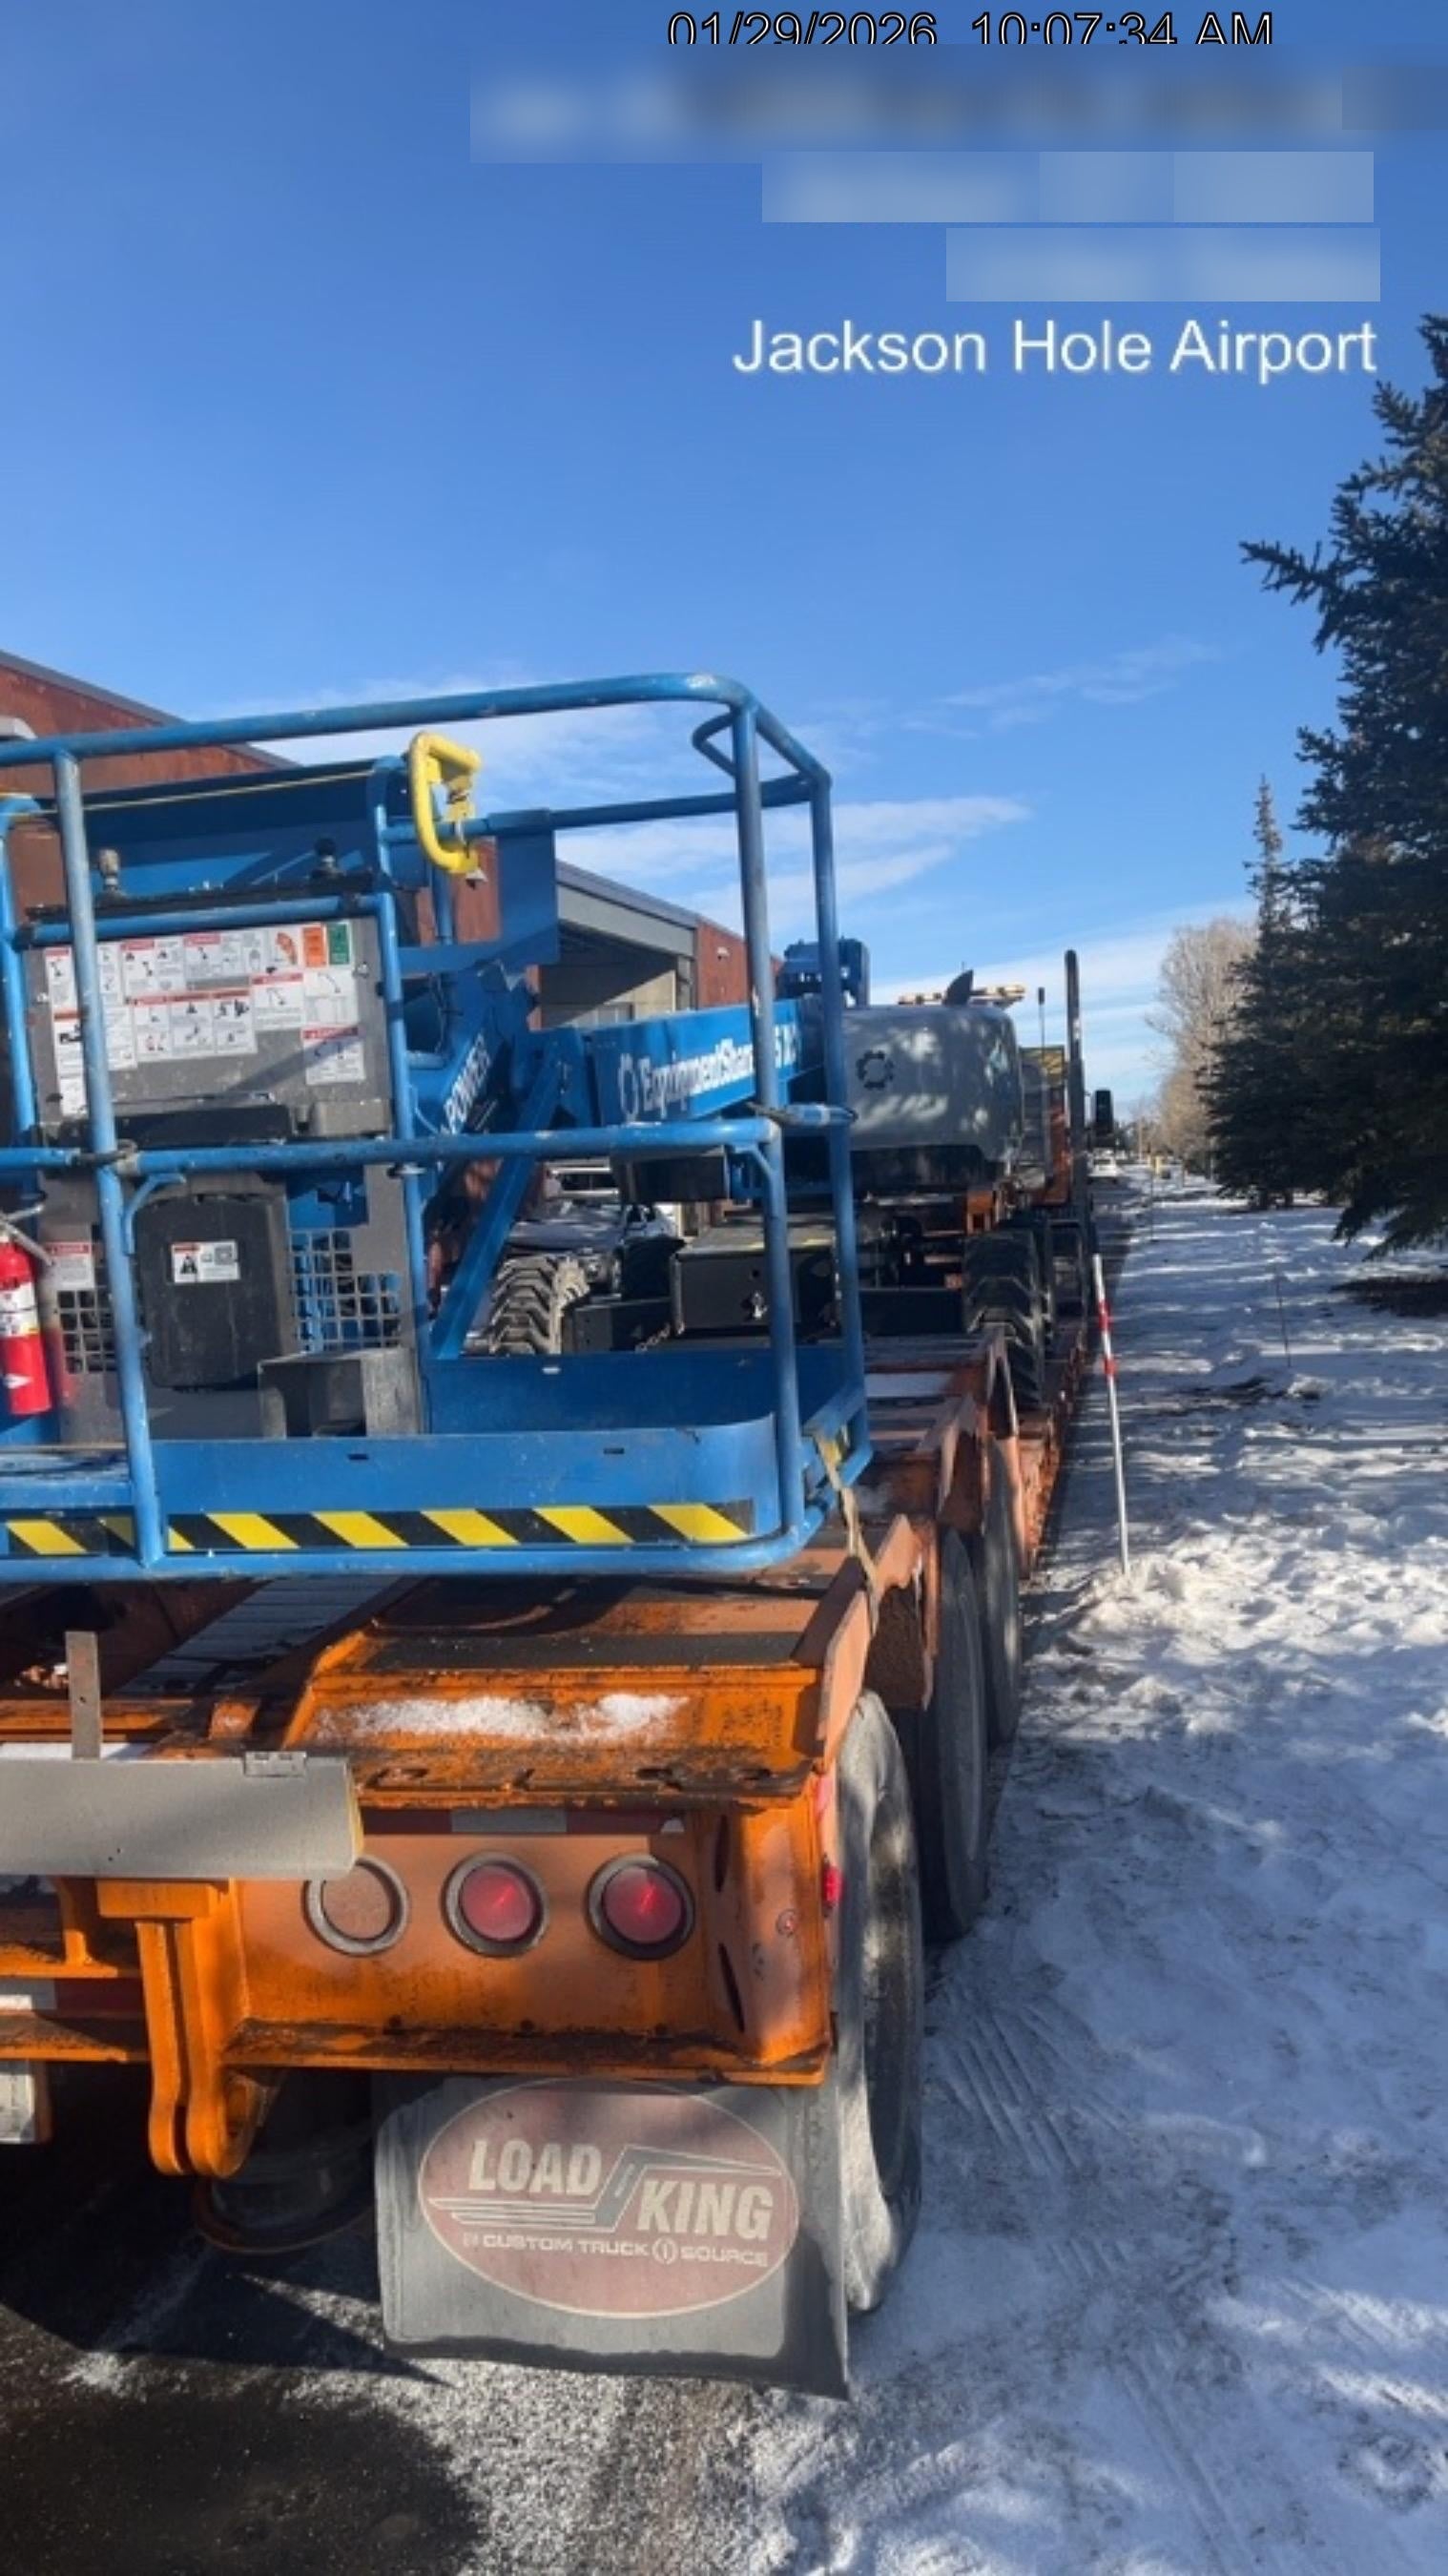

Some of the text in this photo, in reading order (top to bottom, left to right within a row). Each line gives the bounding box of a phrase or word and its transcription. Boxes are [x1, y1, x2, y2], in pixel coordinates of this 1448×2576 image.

[468, 2140, 603, 2195] LOAD
[636, 2178, 774, 2240] KING
[483, 2233, 573, 2253] CUSTOM
[578, 2239, 651, 2257] TRUCK
[680, 2246, 769, 2268] SOURCE
